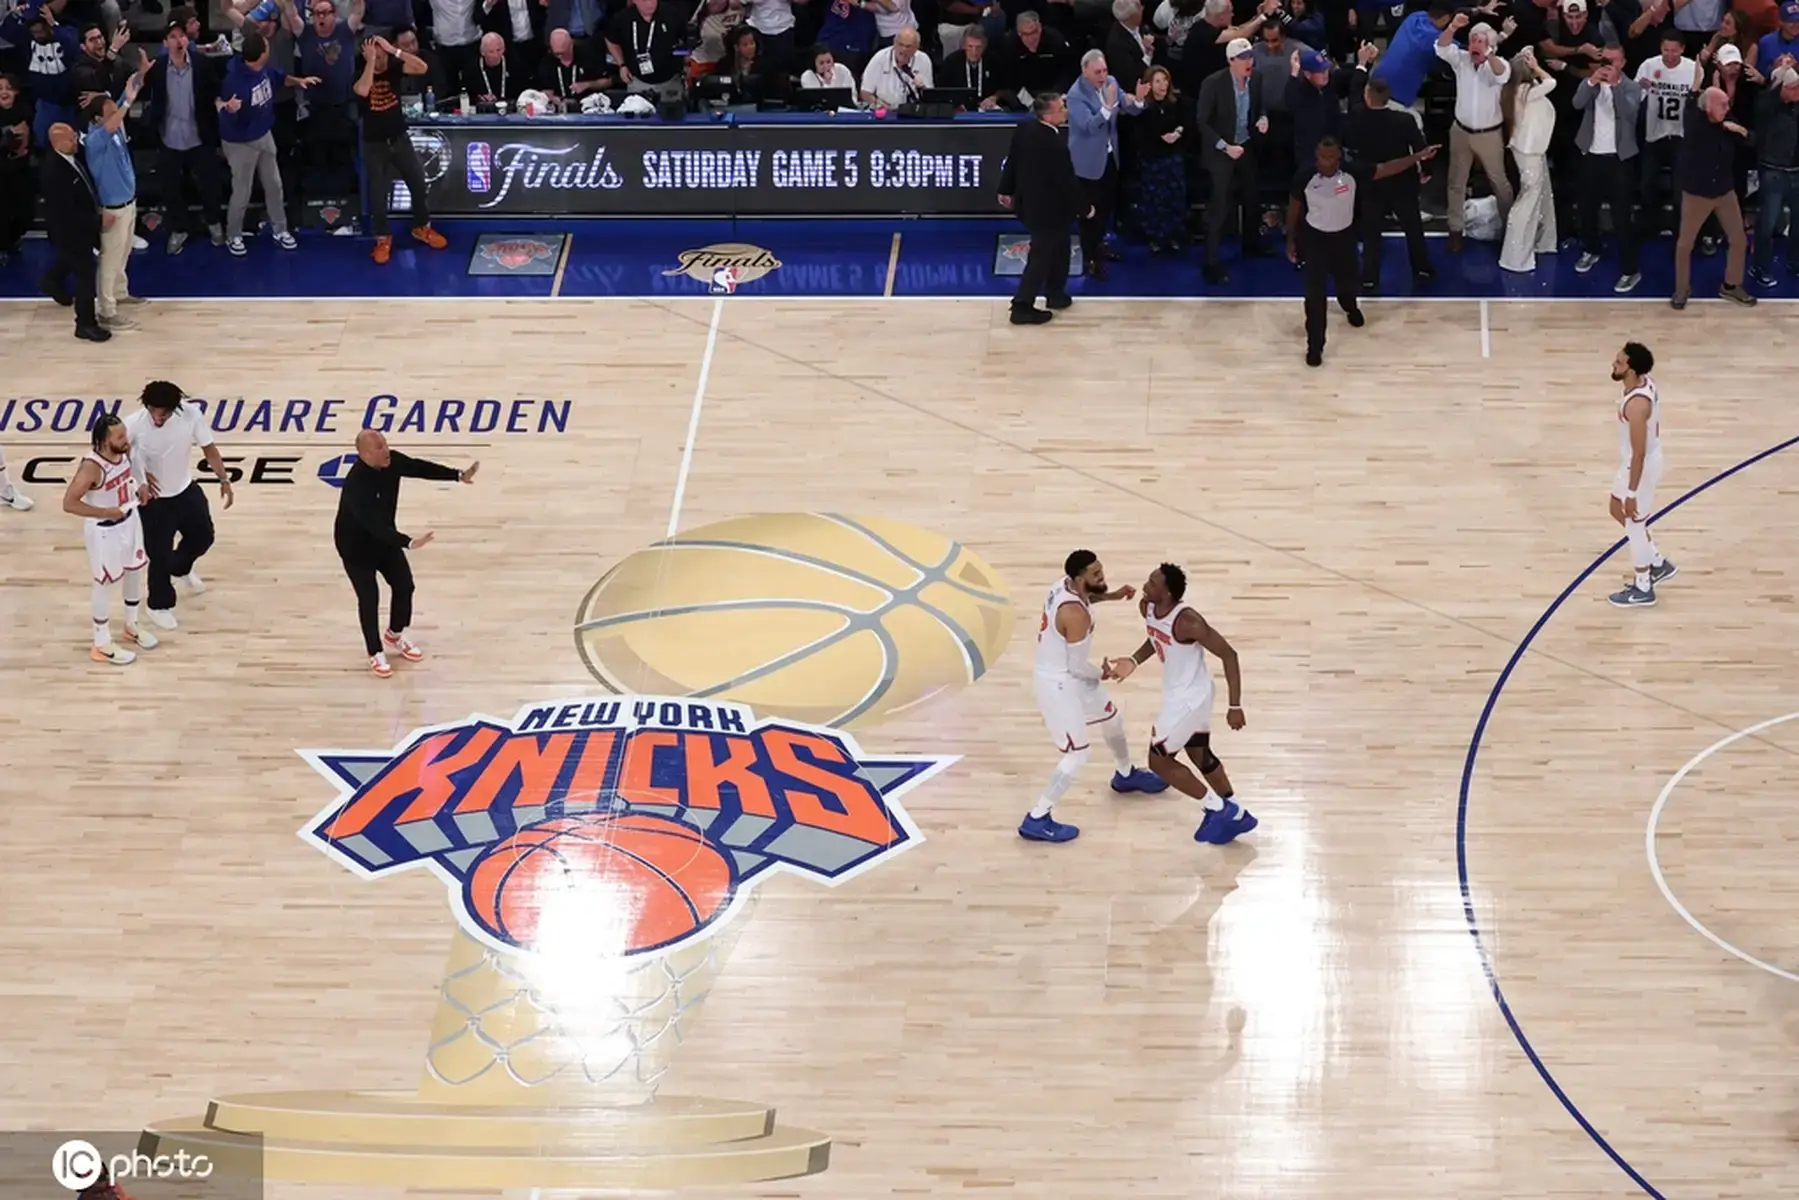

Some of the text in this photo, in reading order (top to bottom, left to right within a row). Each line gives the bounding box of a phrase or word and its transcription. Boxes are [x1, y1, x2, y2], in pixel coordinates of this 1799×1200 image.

[1657, 96, 1680, 120] 12
[478, 143, 983, 208] Finals SATURDAY GAME 5 8:30PM ET
[662, 250, 780, 275] Finals
[187, 399, 345, 432] UARE
[22, 457, 302, 484] CSE
[516, 701, 746, 733] NEW YORK
[323, 726, 899, 848] KNICKS
